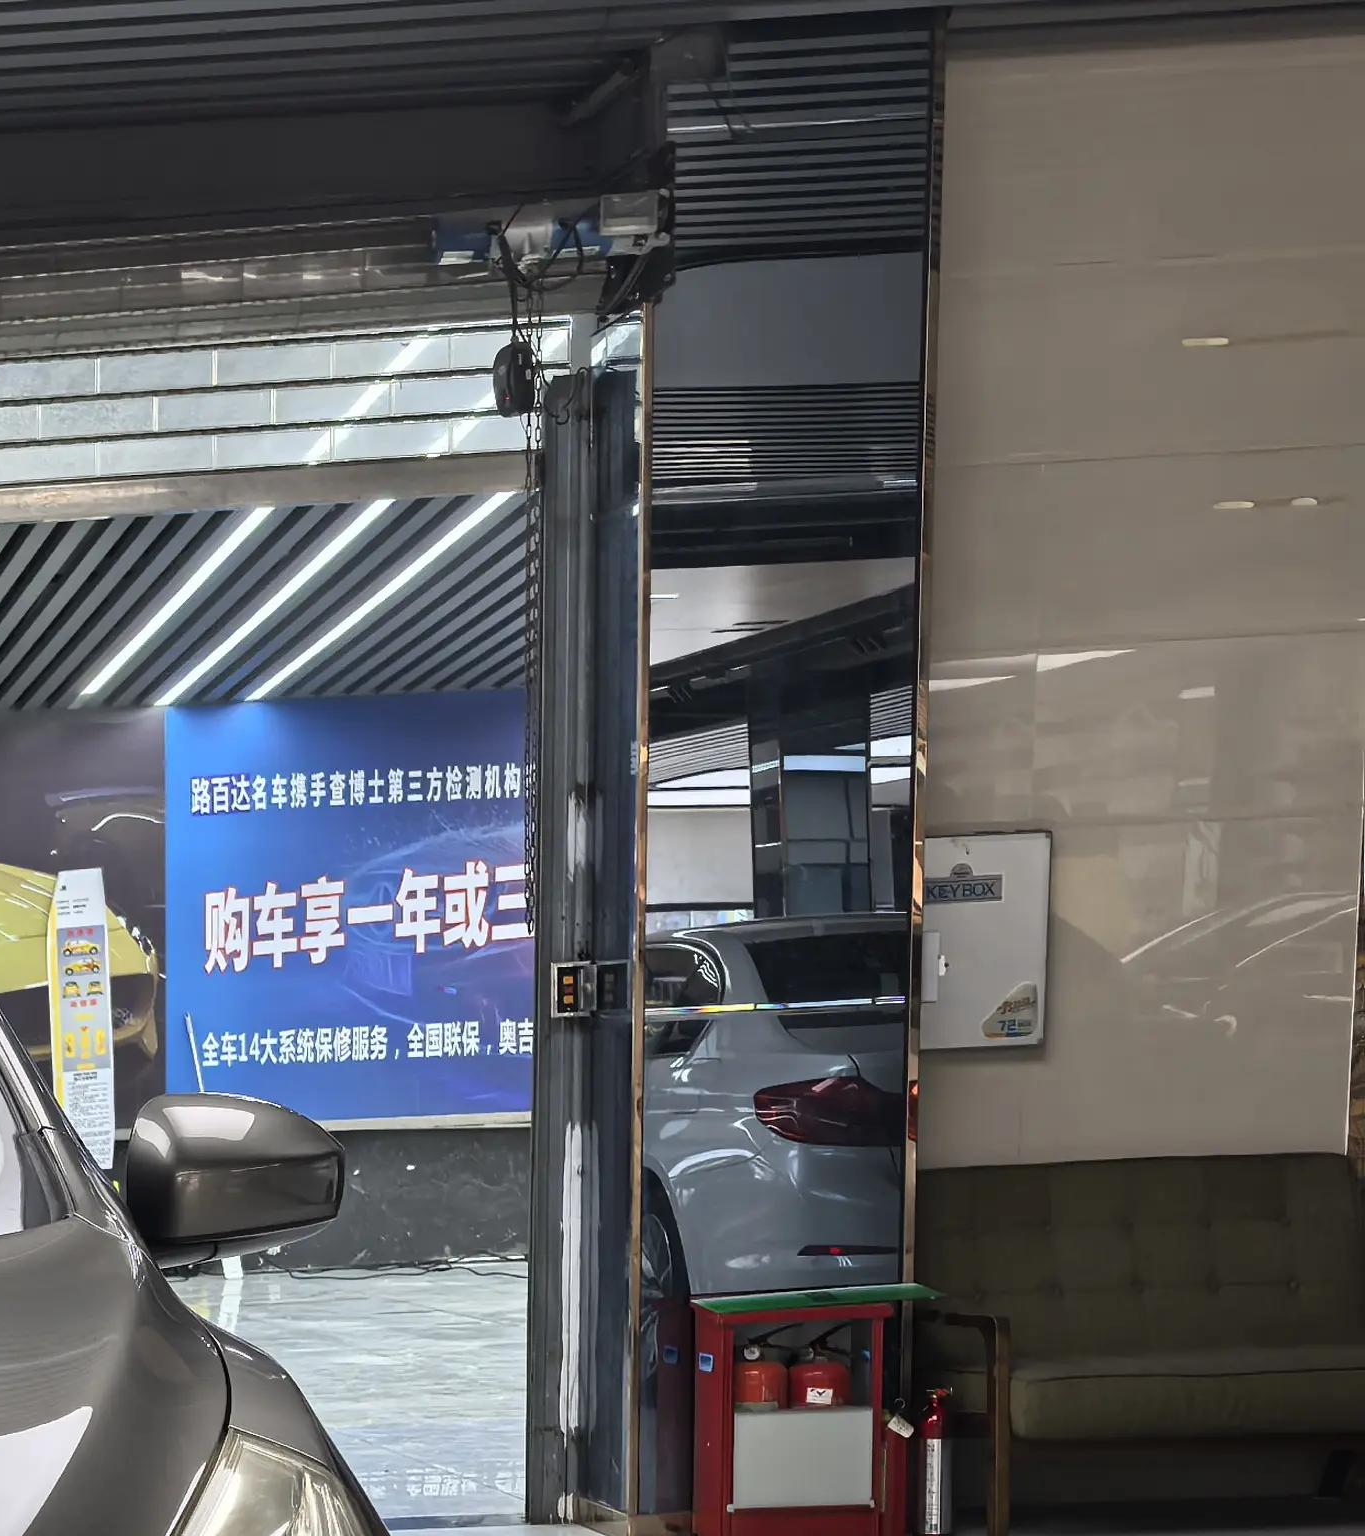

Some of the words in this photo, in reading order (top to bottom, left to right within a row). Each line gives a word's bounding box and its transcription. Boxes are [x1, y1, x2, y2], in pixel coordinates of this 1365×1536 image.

[203, 859, 535, 975] 购车享一年或三
